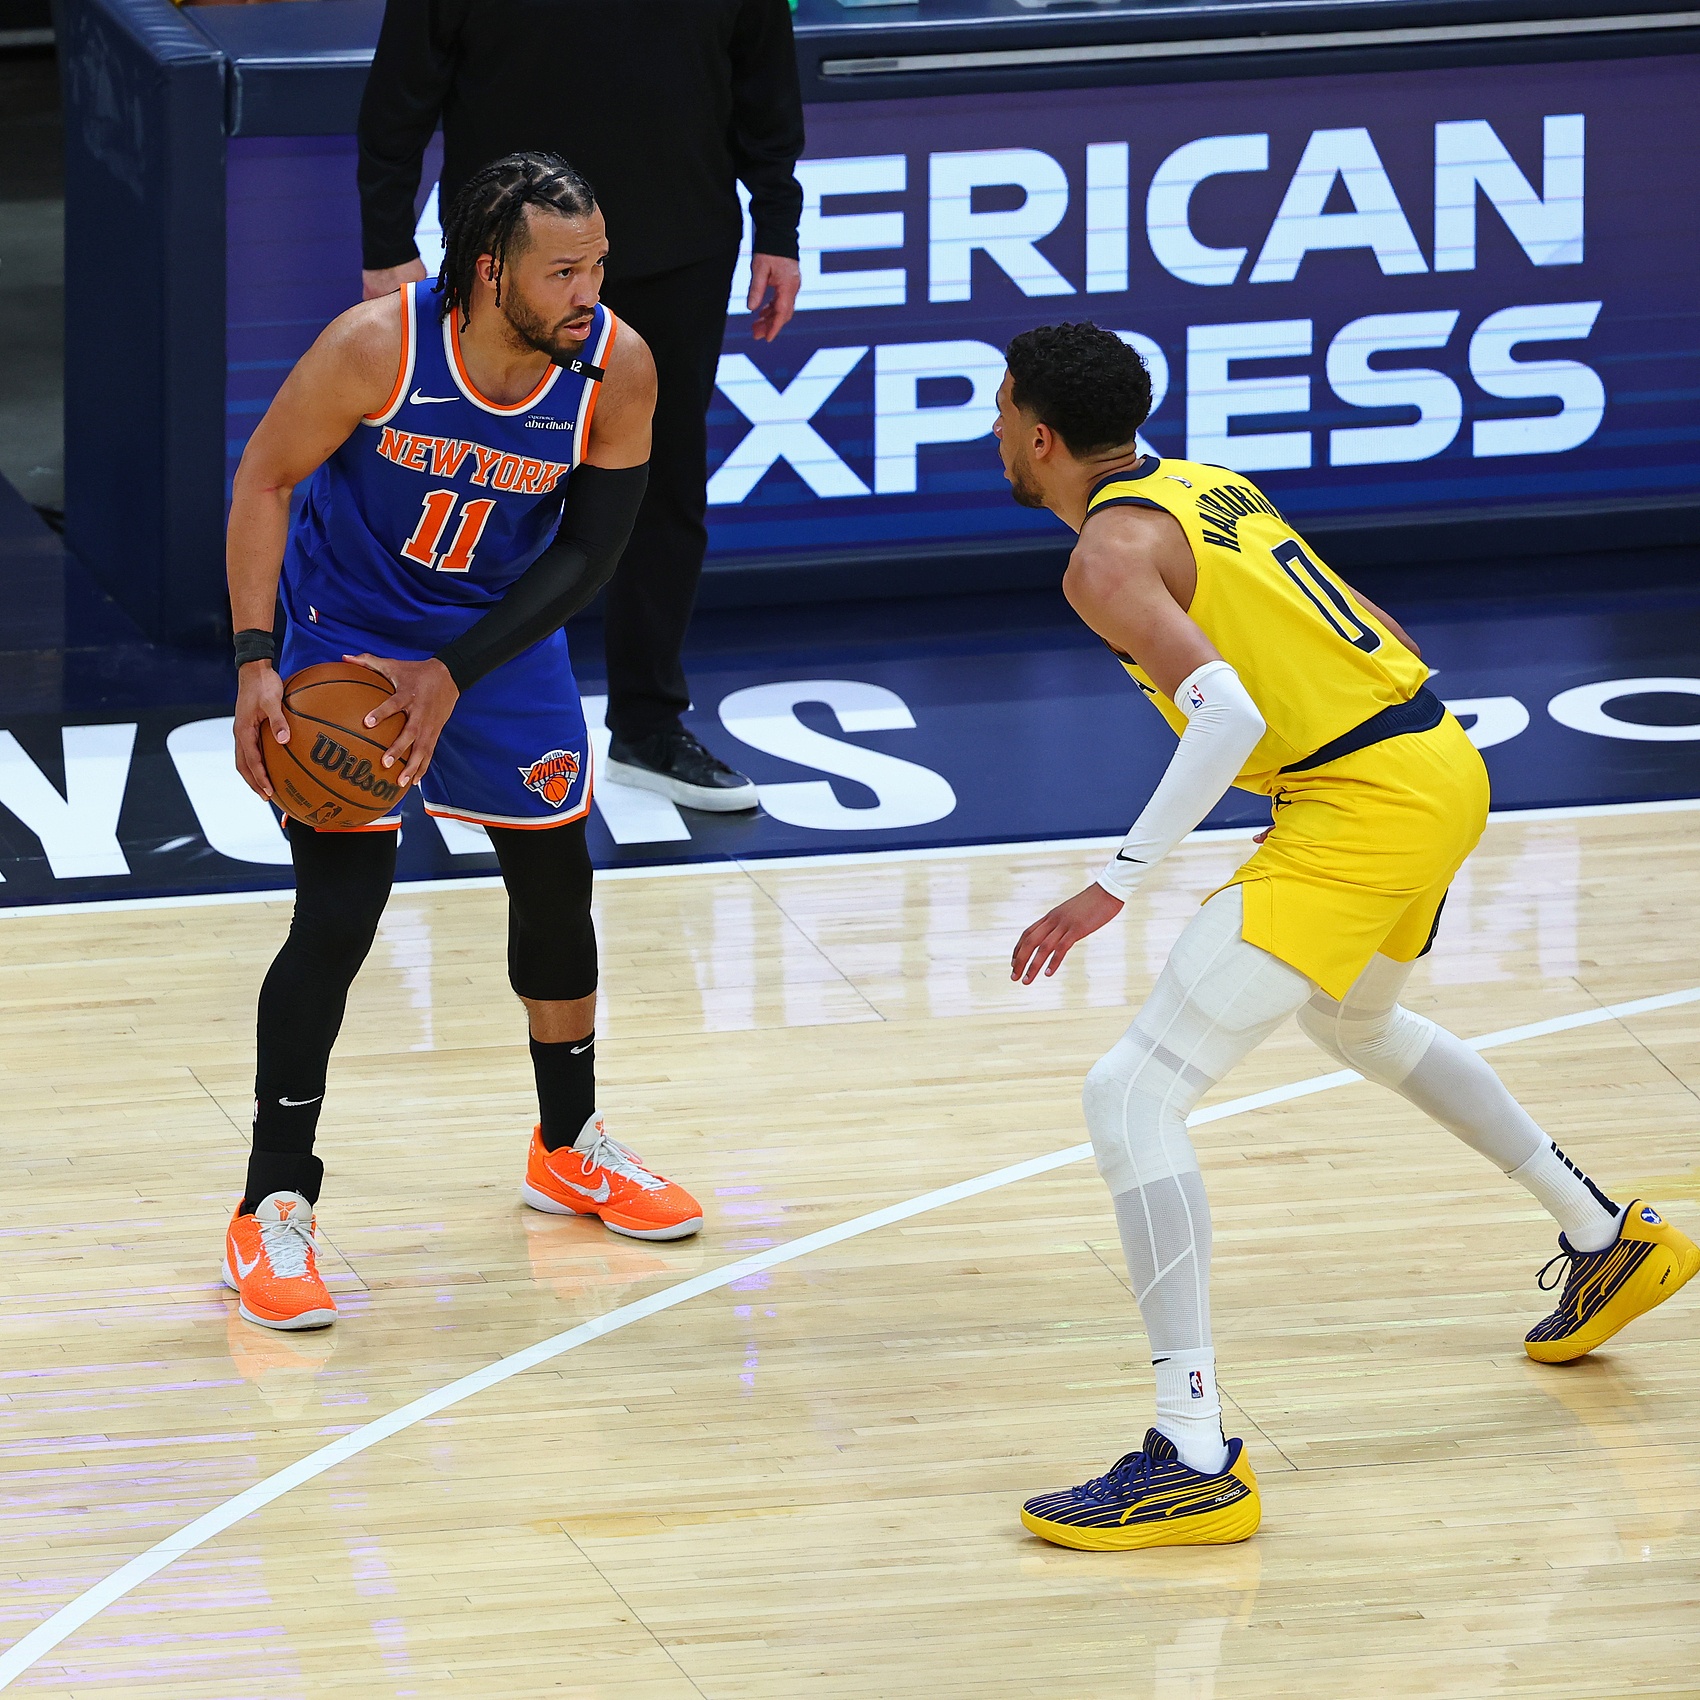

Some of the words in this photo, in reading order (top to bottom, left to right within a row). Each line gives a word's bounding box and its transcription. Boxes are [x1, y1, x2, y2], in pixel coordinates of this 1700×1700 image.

[414, 113, 1586, 316] ERICAN
[569, 359, 583, 373] 12
[525, 419, 545, 429] abu
[545, 420, 575, 431] dhabi
[705, 300, 1606, 506] XPESS
[376, 426, 472, 478] NEW
[469, 443, 571, 495] YORK
[400, 488, 498, 573] 11
[1270, 537, 1383, 655] 0
[310, 731, 401, 802] Wilson
[526, 753, 579, 785] KNICKS
